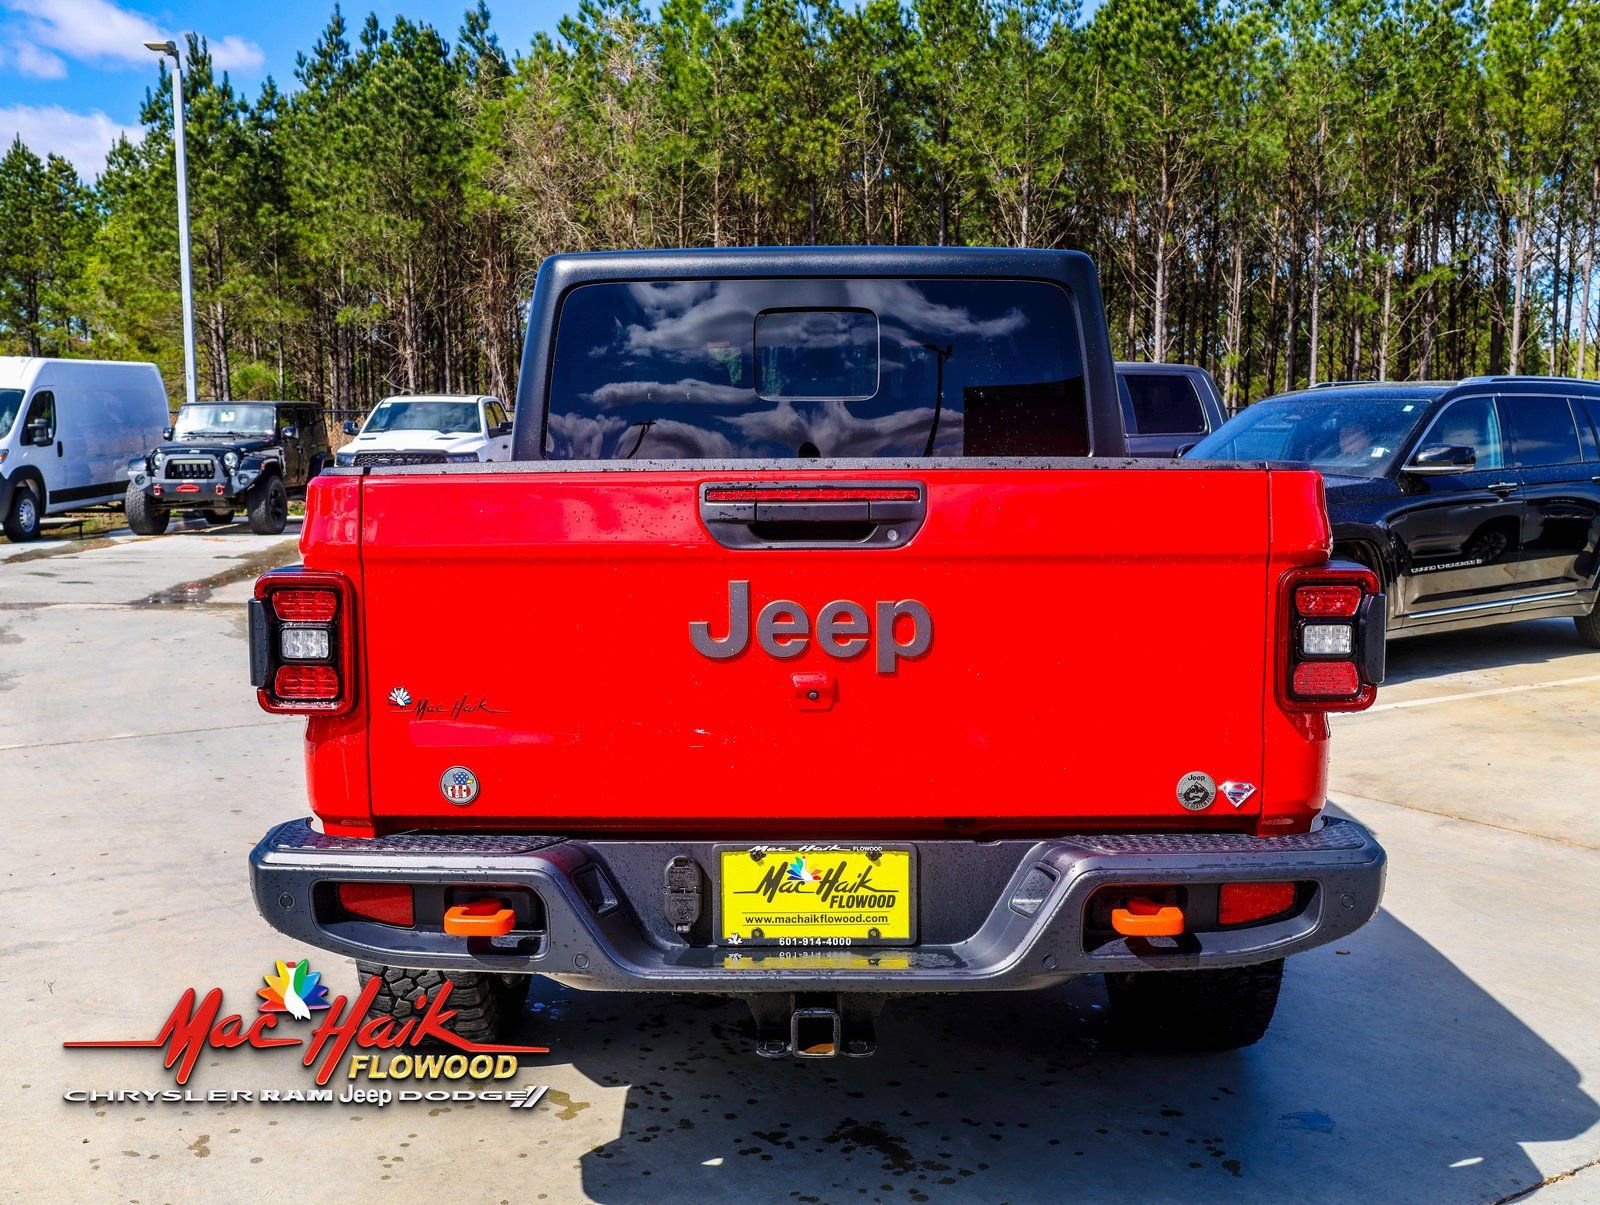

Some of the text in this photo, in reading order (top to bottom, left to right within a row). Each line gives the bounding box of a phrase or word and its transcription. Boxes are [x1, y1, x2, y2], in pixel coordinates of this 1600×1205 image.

[688, 579, 933, 674] Jeep
[391, 694, 510, 721] Mac Haik
[733, 861, 815, 903] Mac
[815, 860, 899, 903] Haik
[829, 894, 897, 909] FLOWOOD
[745, 913, 889, 924] www.machaikflowood.com
[779, 937, 852, 946] 601-914-4000
